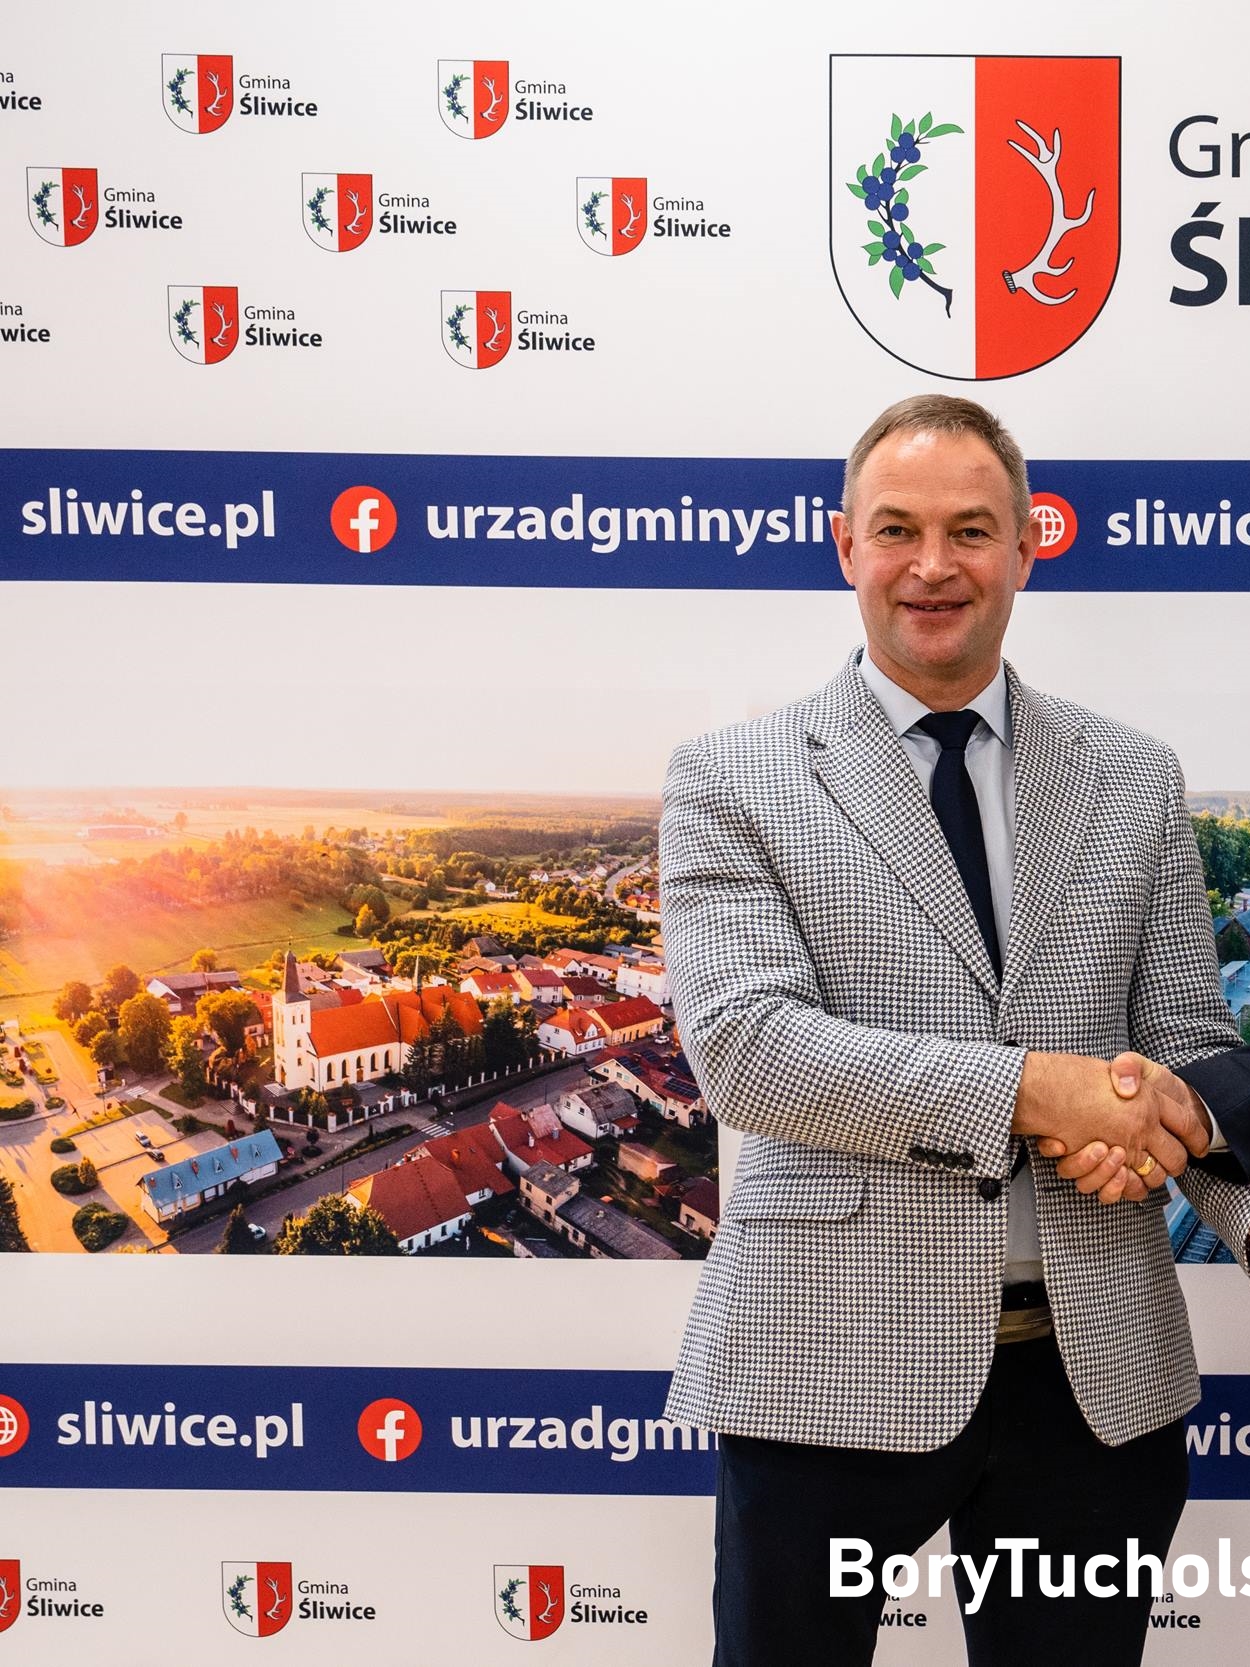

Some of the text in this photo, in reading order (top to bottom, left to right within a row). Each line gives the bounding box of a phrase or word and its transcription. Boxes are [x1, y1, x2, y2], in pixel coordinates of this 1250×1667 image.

[240, 75, 290, 89] Gmina
[515, 80, 565, 94] Gmina
[240, 93, 317, 116] Śliwice
[516, 98, 593, 120] Śliwice
[104, 188, 154, 202] Gmina
[379, 194, 429, 207] Gmina
[654, 197, 703, 210] Gmina
[105, 206, 182, 229] Śliwice
[380, 212, 456, 234] Śliwice
[654, 215, 730, 237] Śliwice
[245, 306, 294, 320] Gmina
[518, 311, 567, 324] Gmina
[0, 324, 50, 342] wice
[246, 324, 322, 347] Śliwice
[518, 329, 595, 351] Śliwice
[22, 488, 274, 548] sliwice.pl
[427, 494, 839, 555] urzadgminysli
[58, 1401, 303, 1458] sliwice.pl
[27, 1578, 76, 1591] Gmina
[298, 1581, 348, 1594] Gmina
[570, 1584, 620, 1598] Gmina
[27, 1595, 104, 1617] Śliwice
[299, 1598, 376, 1619] Śliwice
[571, 1602, 647, 1623] Śliwice
[880, 1608, 927, 1627] wice
[1151, 1610, 1201, 1628] wice
